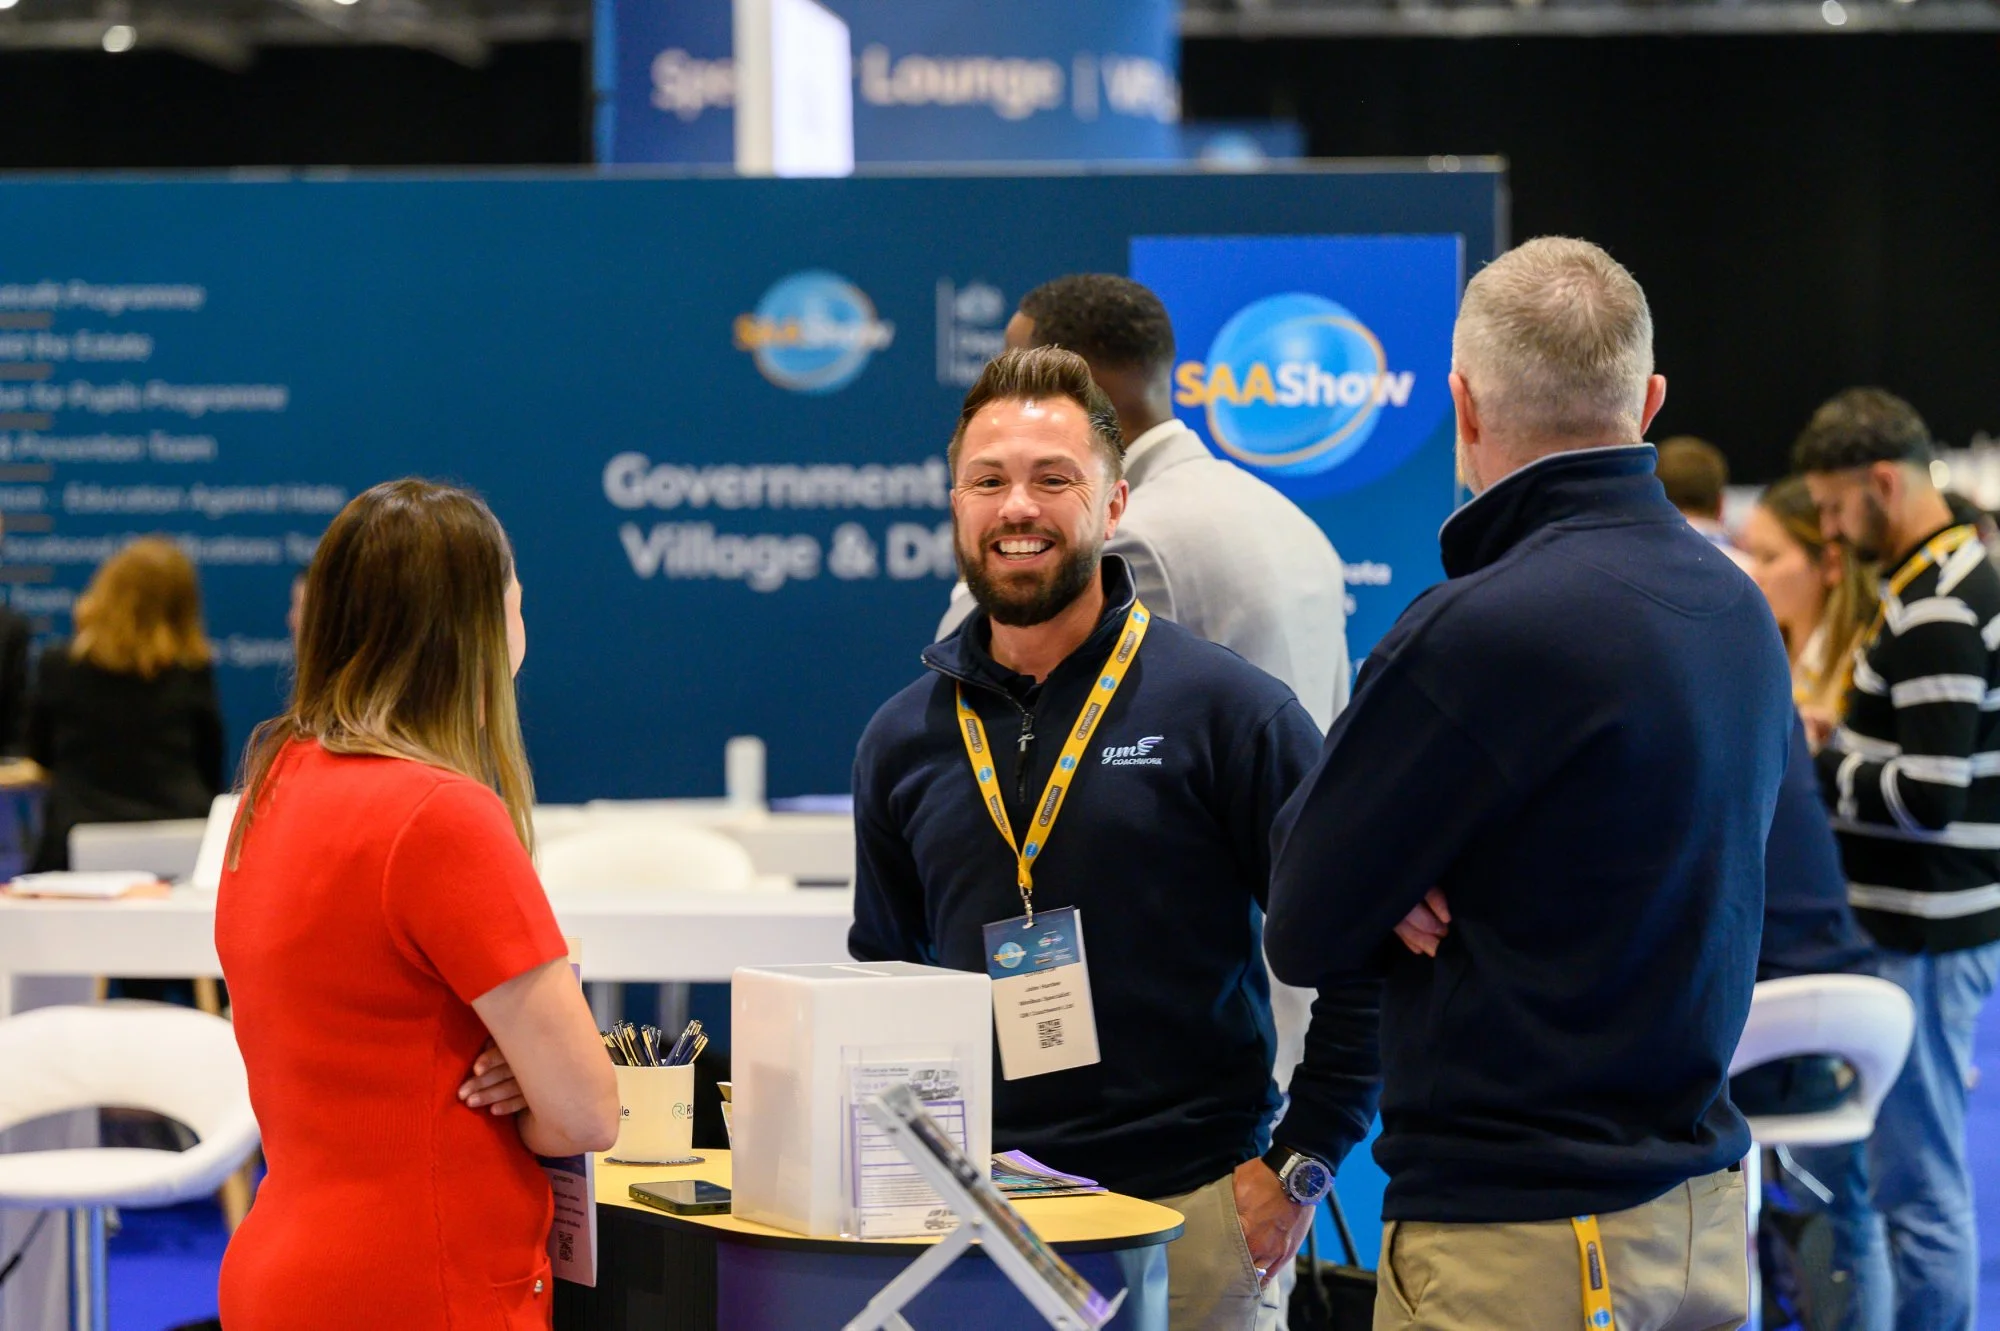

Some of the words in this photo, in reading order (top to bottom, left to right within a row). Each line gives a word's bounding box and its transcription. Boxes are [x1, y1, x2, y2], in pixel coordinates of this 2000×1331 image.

[862, 44, 1063, 119] Lounge
[1175, 361, 1415, 407] SAAShow
[602, 451, 949, 510] Government
[619, 522, 820, 592] Village
[827, 522, 878, 579] &
[886, 521, 956, 580] Df
[1112, 757, 1162, 765] COACHWORK
